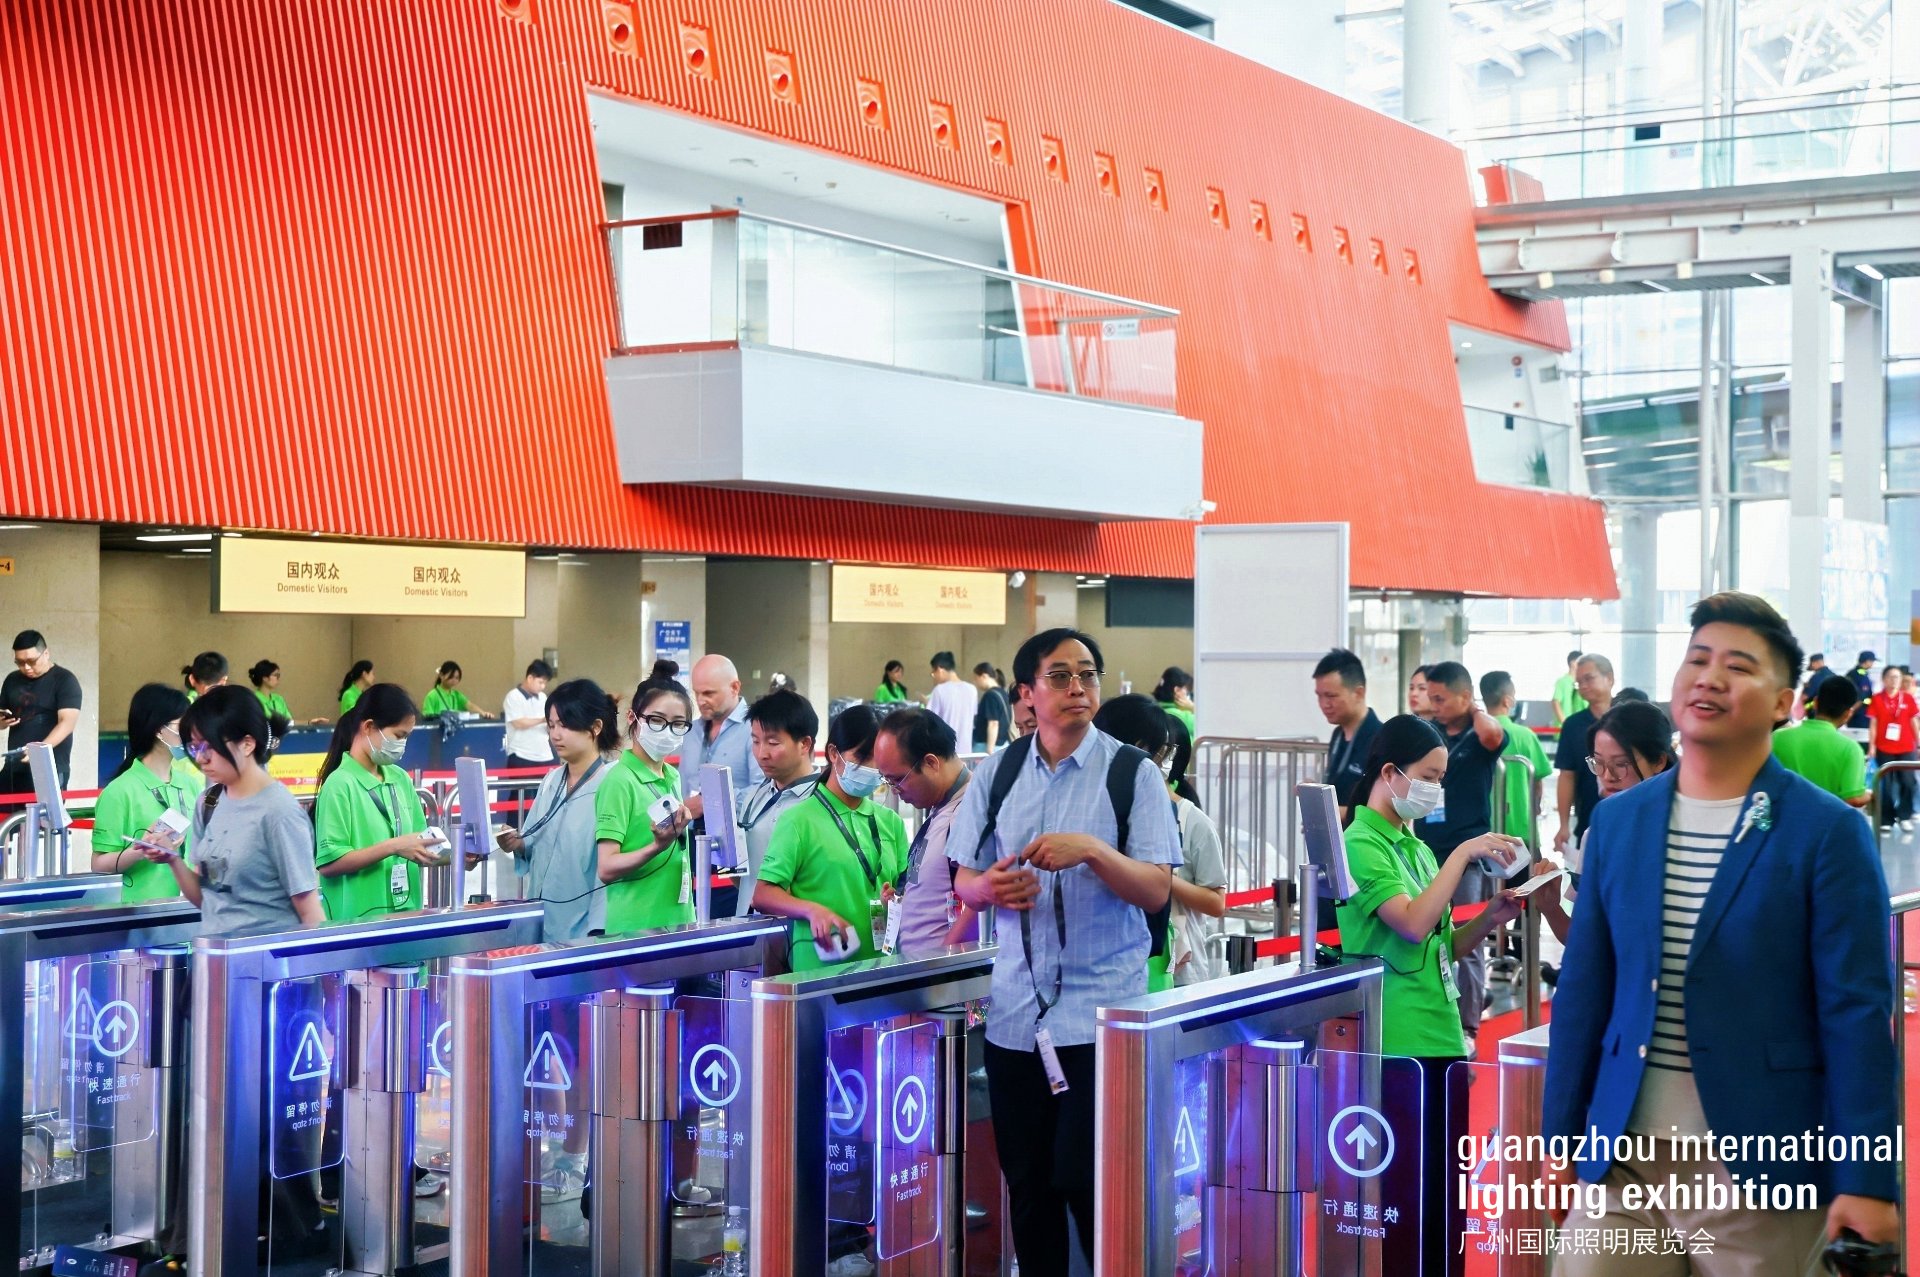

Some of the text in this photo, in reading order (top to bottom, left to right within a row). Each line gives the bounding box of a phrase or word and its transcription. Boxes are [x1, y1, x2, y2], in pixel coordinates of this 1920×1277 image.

[287, 561, 340, 580] 国内观众
[413, 566, 461, 584] 国内观众
[277, 583, 348, 594] Domestic Visitors
[404, 586, 469, 597] Domestic Visitors
[88, 1073, 141, 1093] 快速通行
[890, 1161, 929, 1189] 快速通行
[896, 1190, 909, 1202] Fast
